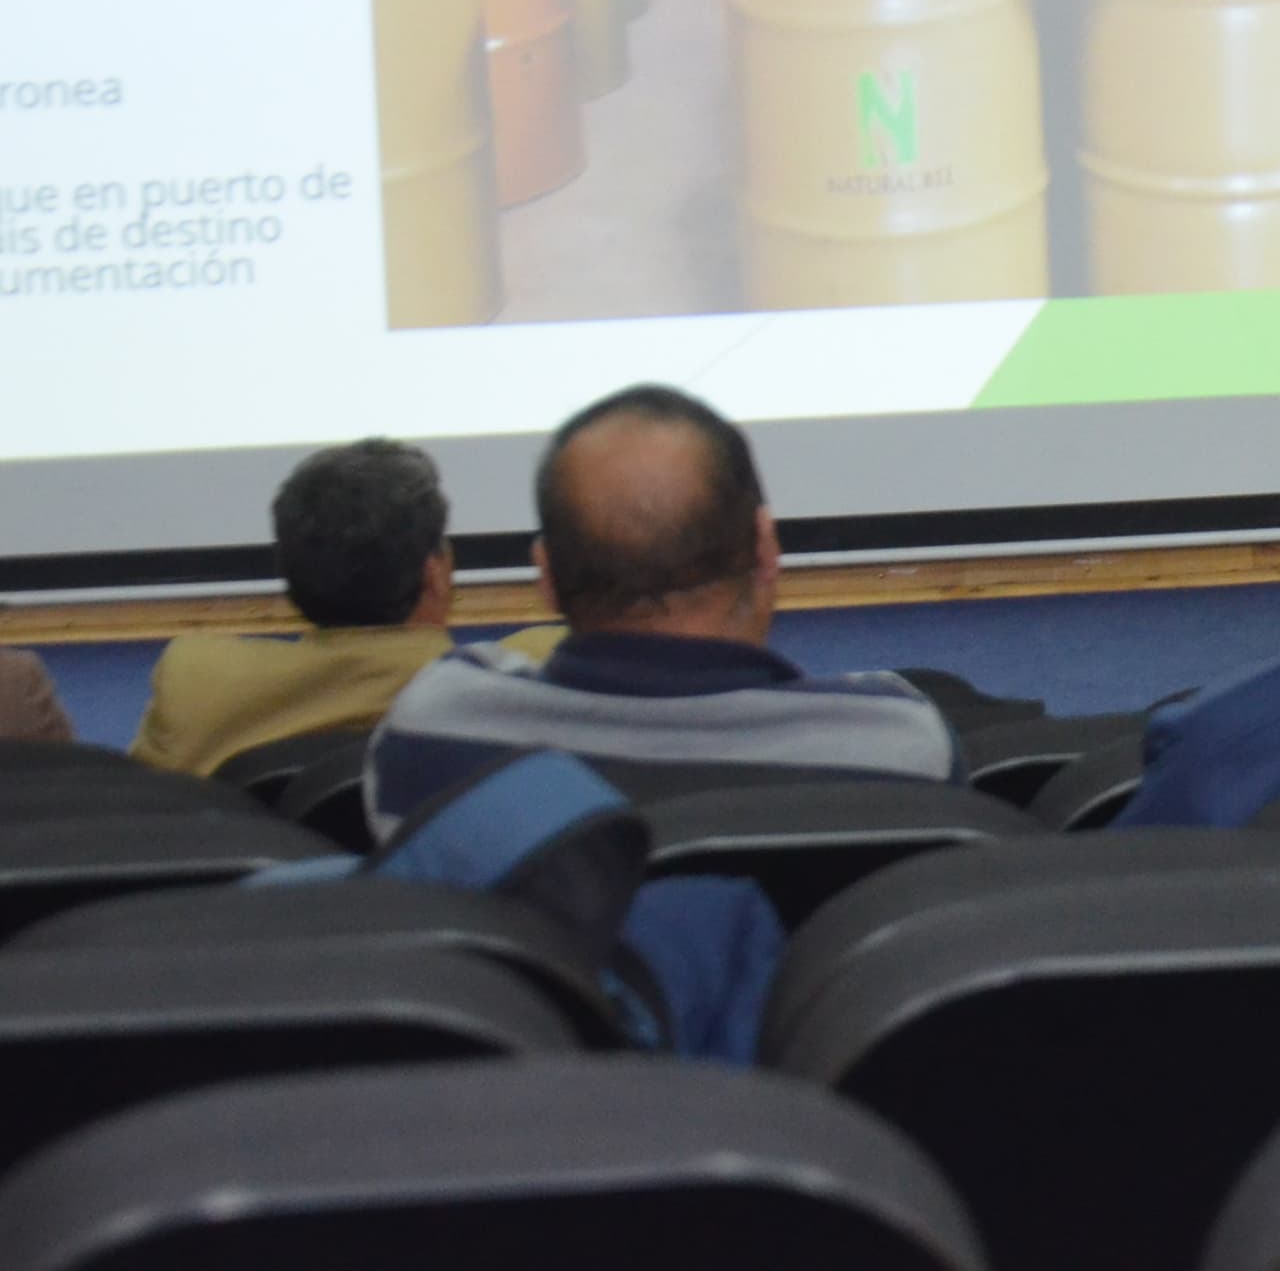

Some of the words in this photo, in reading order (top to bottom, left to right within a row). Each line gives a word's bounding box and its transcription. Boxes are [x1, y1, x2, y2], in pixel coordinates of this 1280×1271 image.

[856, 70, 918, 168] N
[0, 183, 59, 218] ue
[73, 180, 127, 211] en
[141, 169, 286, 220] puerto
[299, 161, 353, 202] de
[53, 215, 109, 253] de
[121, 209, 284, 249] destino
